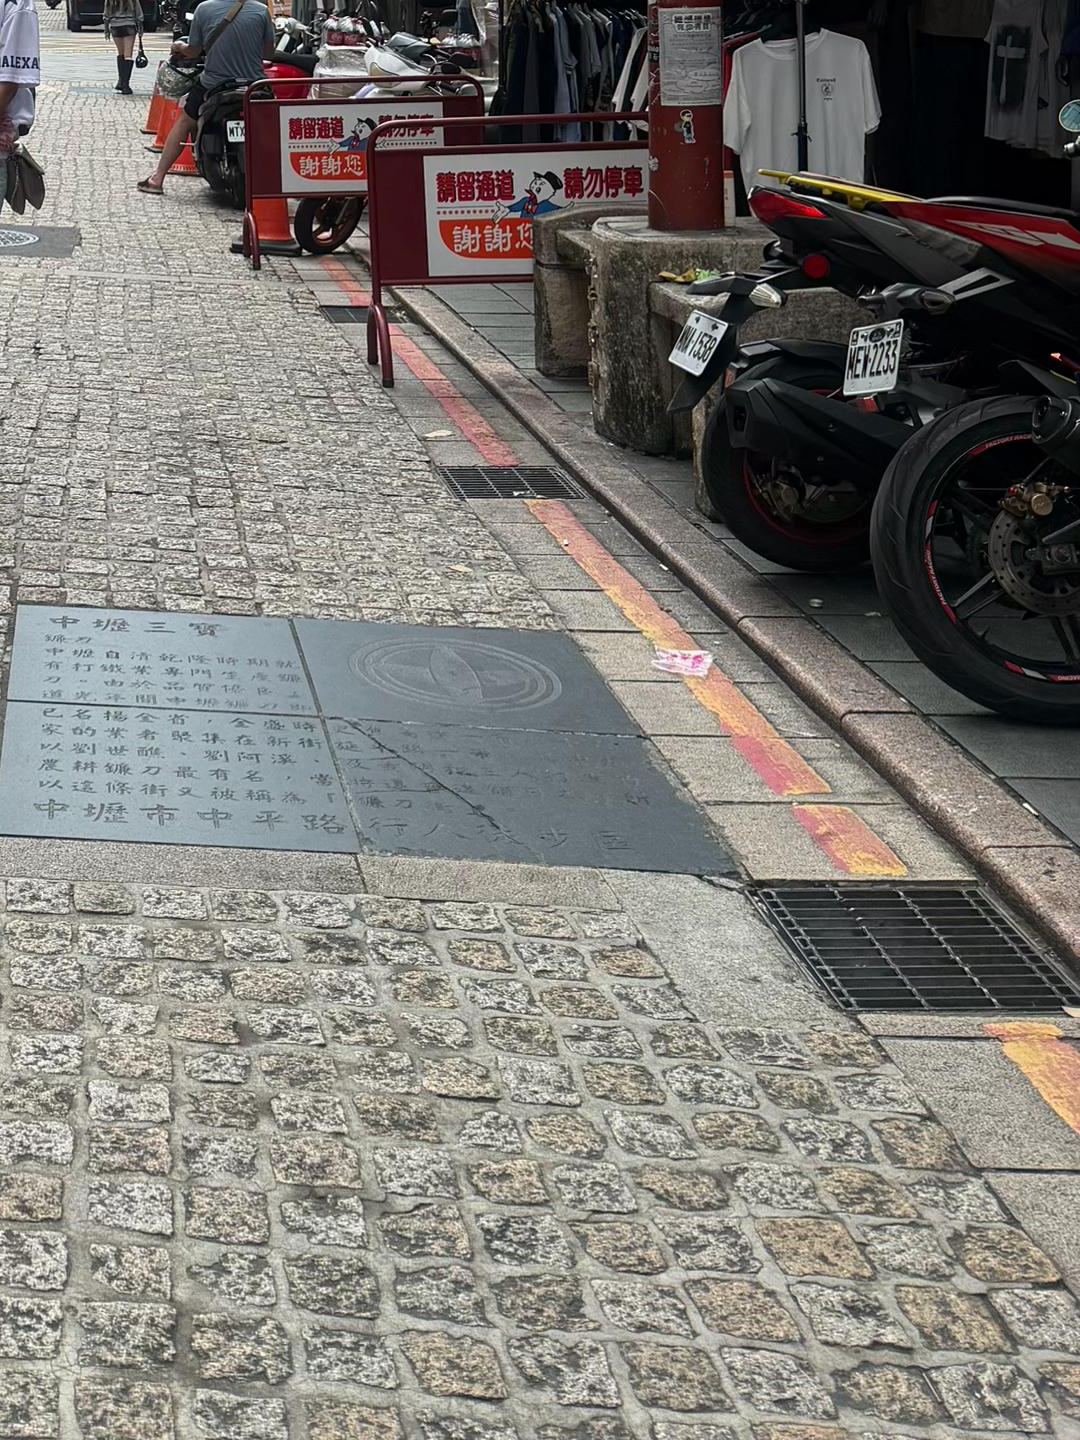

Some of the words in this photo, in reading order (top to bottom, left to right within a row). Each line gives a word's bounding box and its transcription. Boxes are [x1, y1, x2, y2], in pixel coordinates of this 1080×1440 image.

[288, 117, 344, 140] 請留通道
[299, 156, 364, 177] 謝謝您
[436, 169, 515, 204] 請留通道
[563, 166, 644, 200] 請勿停車
